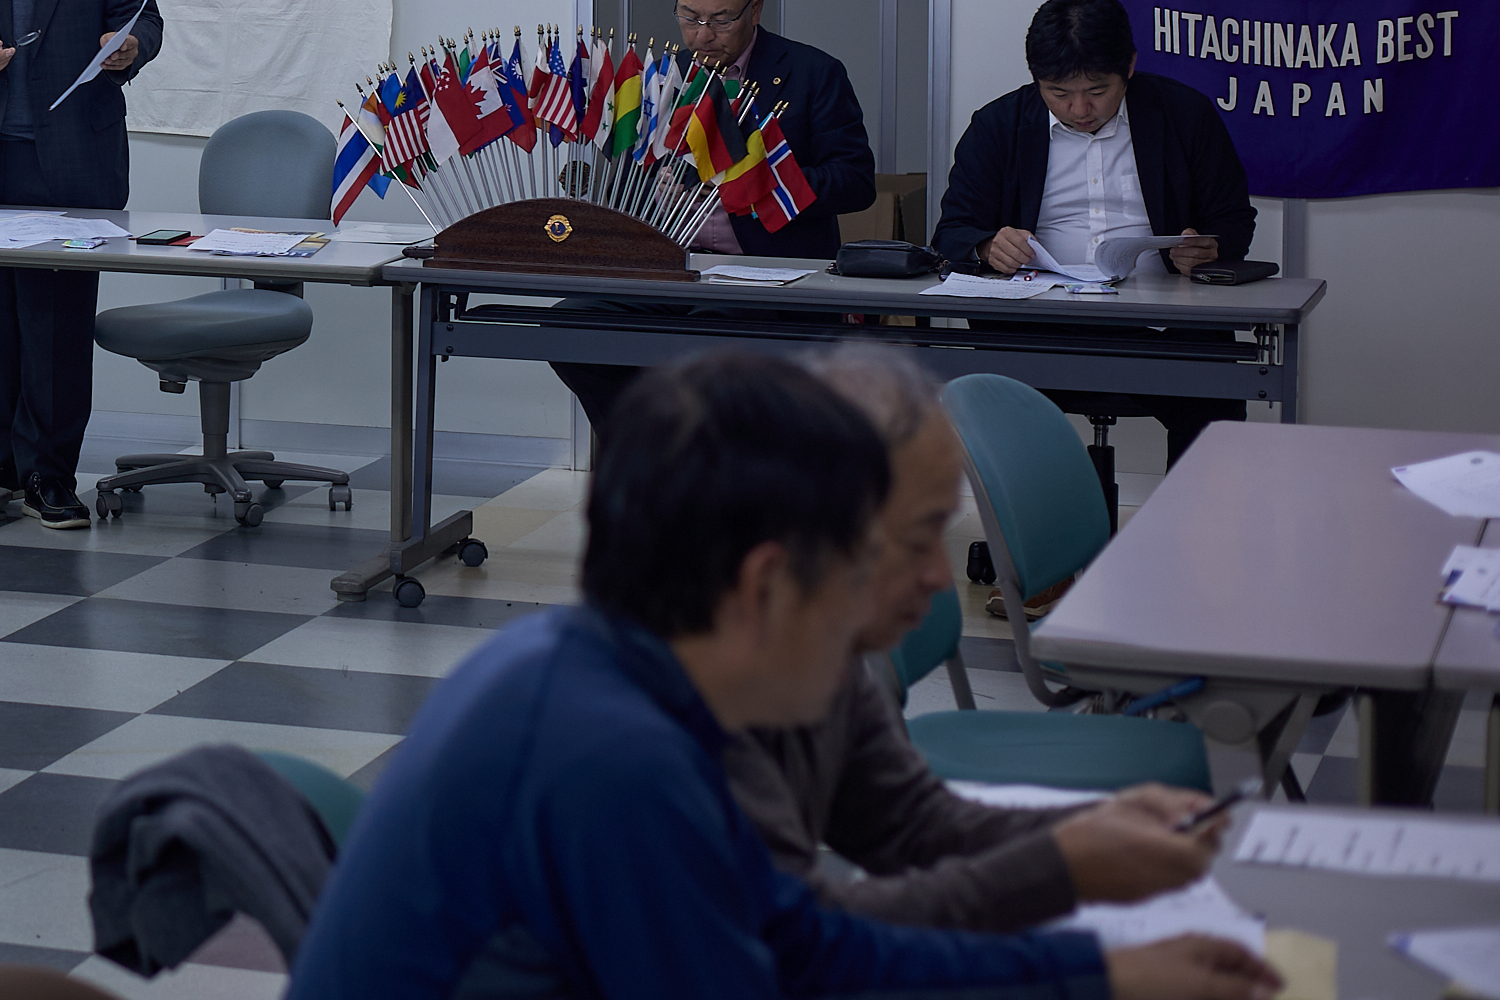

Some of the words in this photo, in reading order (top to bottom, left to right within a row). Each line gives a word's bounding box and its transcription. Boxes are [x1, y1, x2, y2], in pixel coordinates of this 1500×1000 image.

[1153, 7, 1360, 69] HITACHINAKA
[1376, 10, 1459, 65] BEST
[1216, 77, 1385, 117] JAPAN
